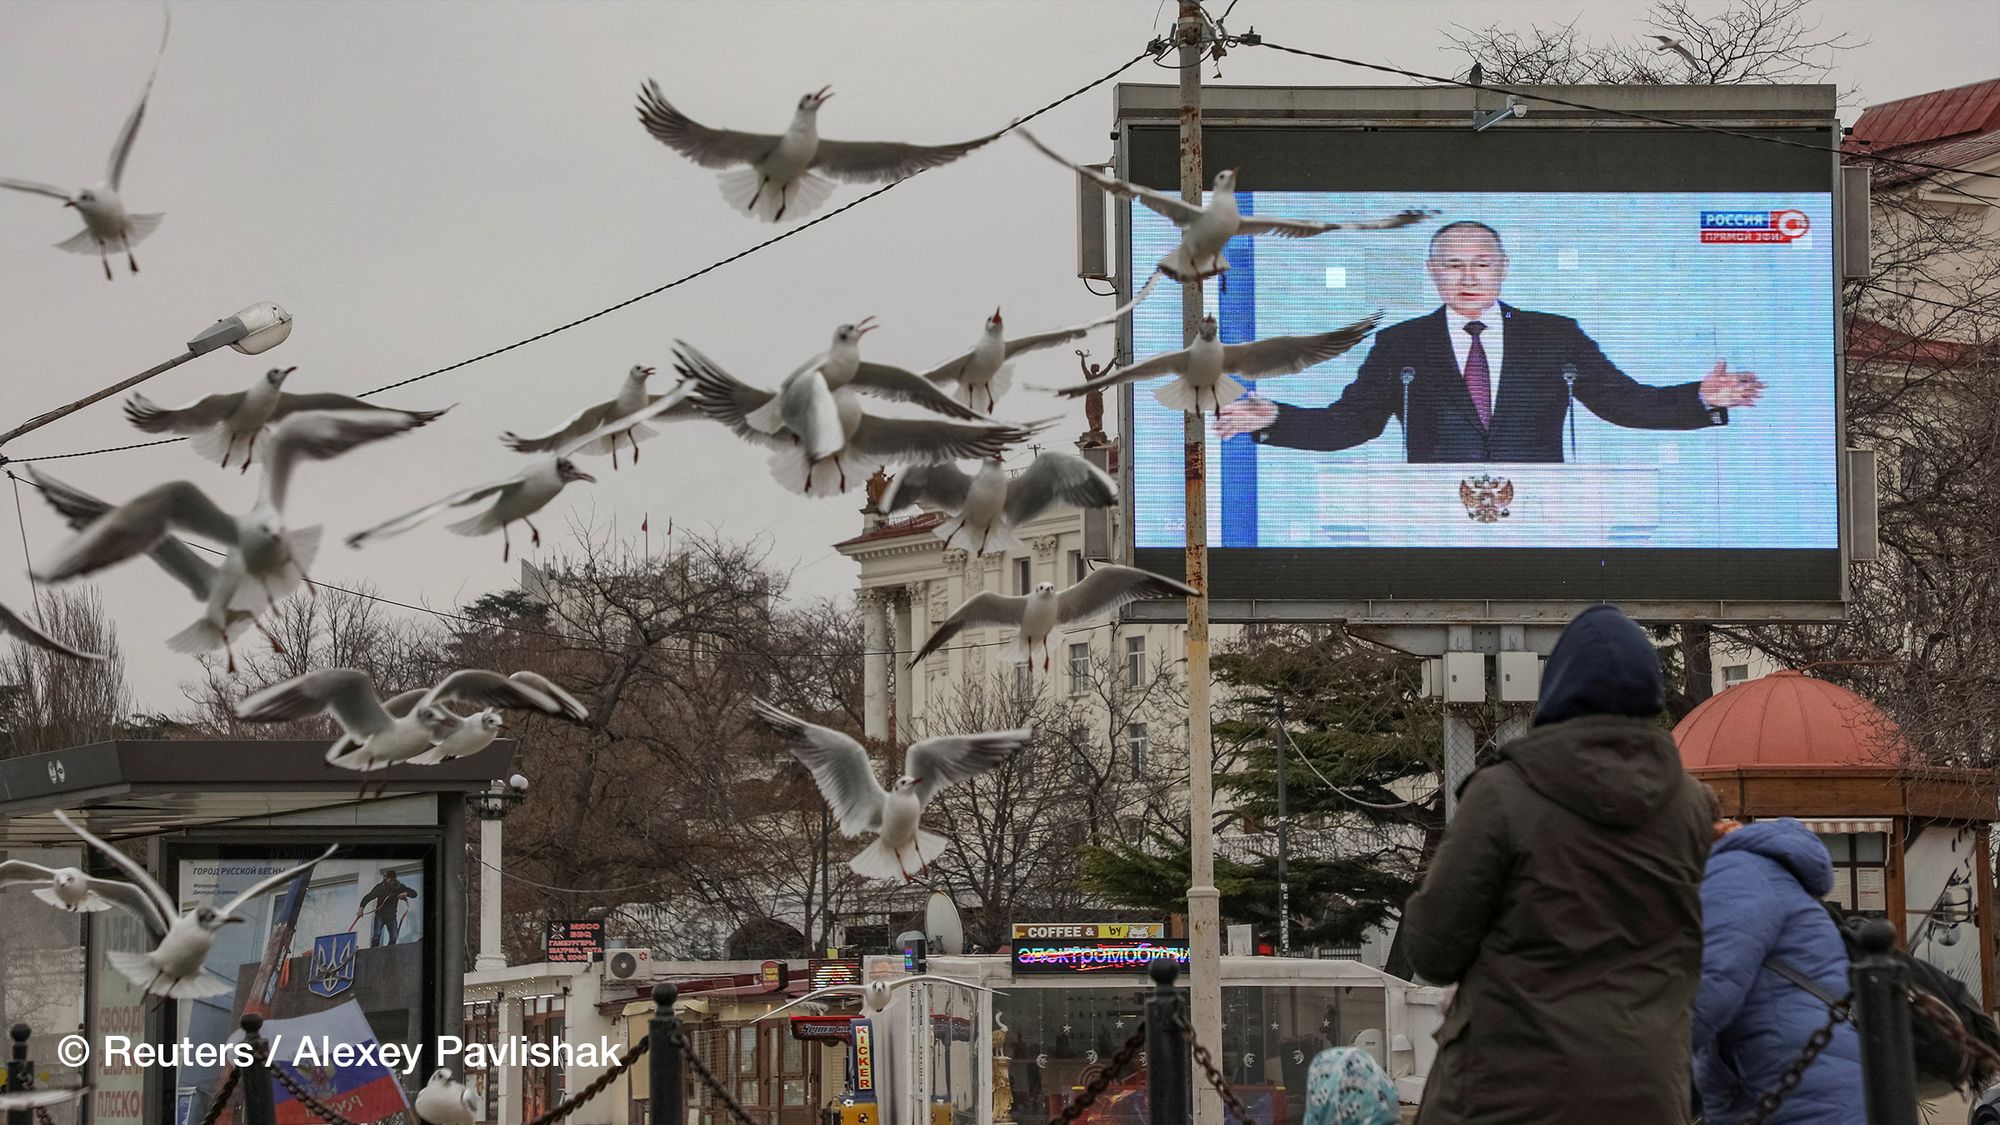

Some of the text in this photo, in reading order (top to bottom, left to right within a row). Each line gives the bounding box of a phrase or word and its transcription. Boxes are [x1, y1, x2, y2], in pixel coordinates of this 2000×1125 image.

[1706, 214, 1763, 226] РОССИЯ
[1705, 232, 1751, 241] ПРЯМОЙ
[193, 867, 219, 876] ГОРОД
[221, 866, 257, 875] РУССКОЙ
[1028, 926, 1122, 938] COFFEE & by
[857, 1026, 870, 1088] KICKER
